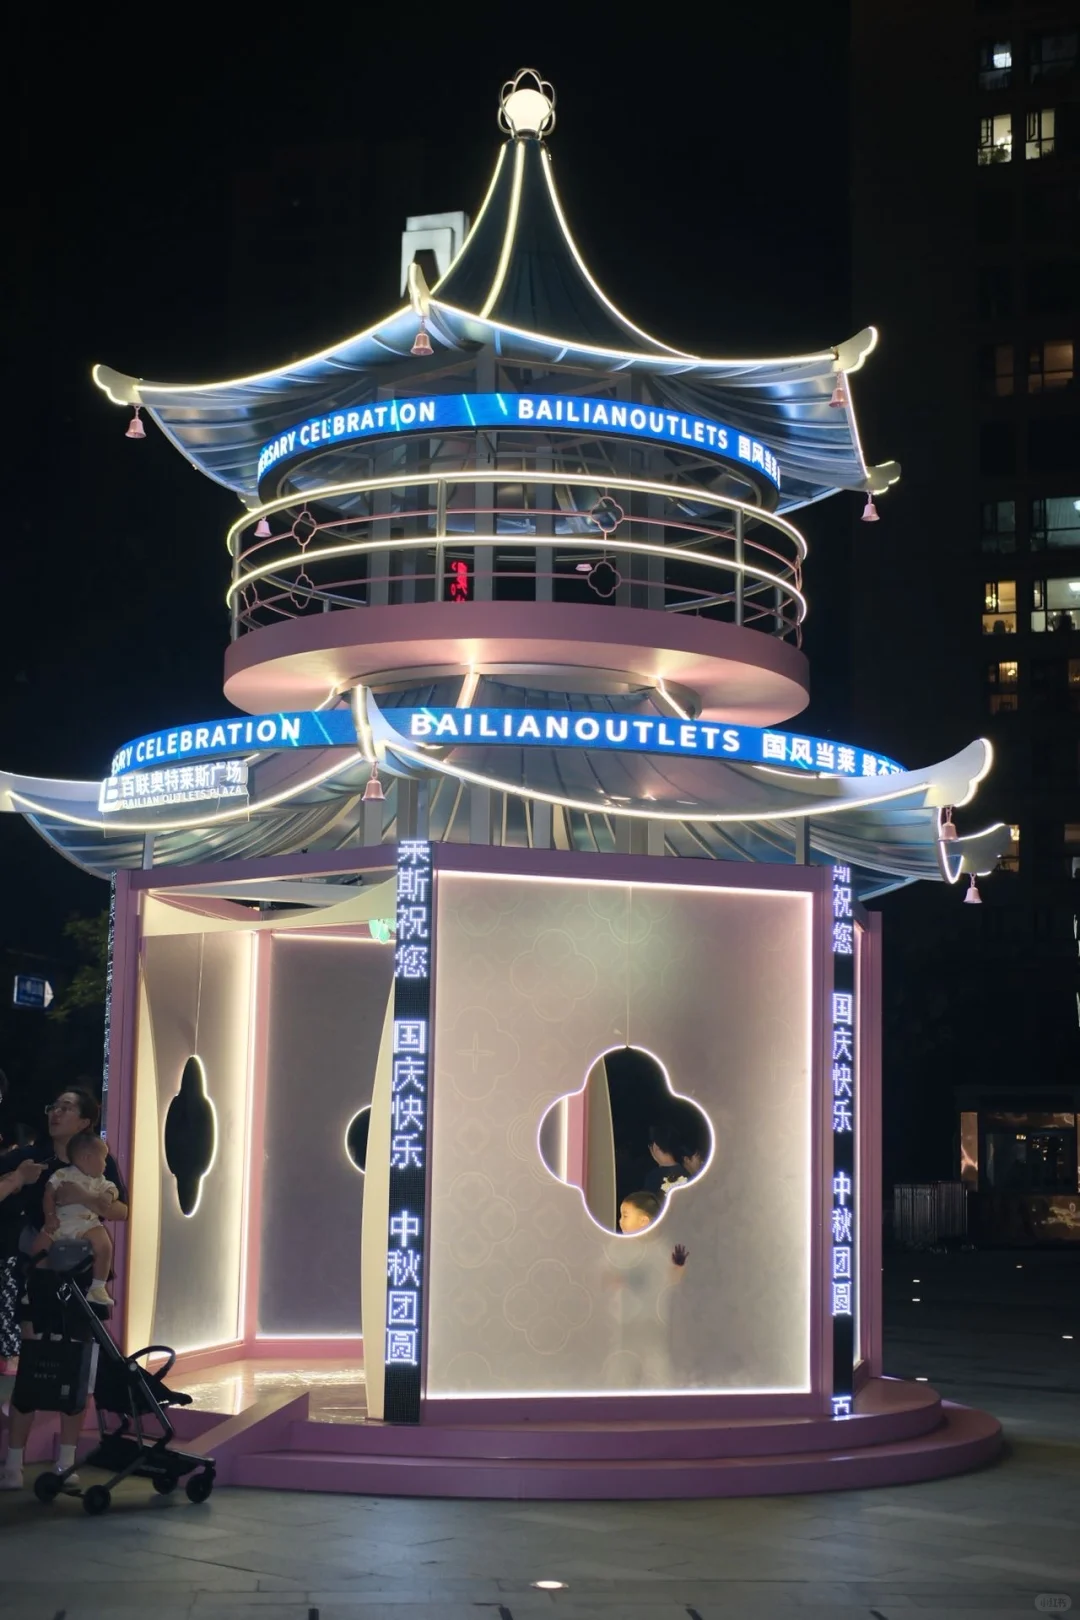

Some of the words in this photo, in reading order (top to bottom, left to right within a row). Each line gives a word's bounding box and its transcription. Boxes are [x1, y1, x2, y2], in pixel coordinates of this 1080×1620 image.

[517, 397, 729, 450] BAILIANOUTLETS
[136, 717, 301, 763] CELEBRATION
[411, 710, 740, 751] BAILIANOUTLETS
[763, 732, 856, 774] 国风当莱
[121, 759, 243, 798] 百联奥特莱斯广场
[122, 794, 160, 808] BAILIAN
[163, 788, 207, 804] OUTLETS
[210, 785, 243, 798] PLAZA
[832, 992, 853, 1133] 国庆快乐
[390, 1020, 426, 1170] 国庆快乐
[831, 1171, 852, 1316] 中秋团圆
[385, 1210, 420, 1365] 中秋团圆
